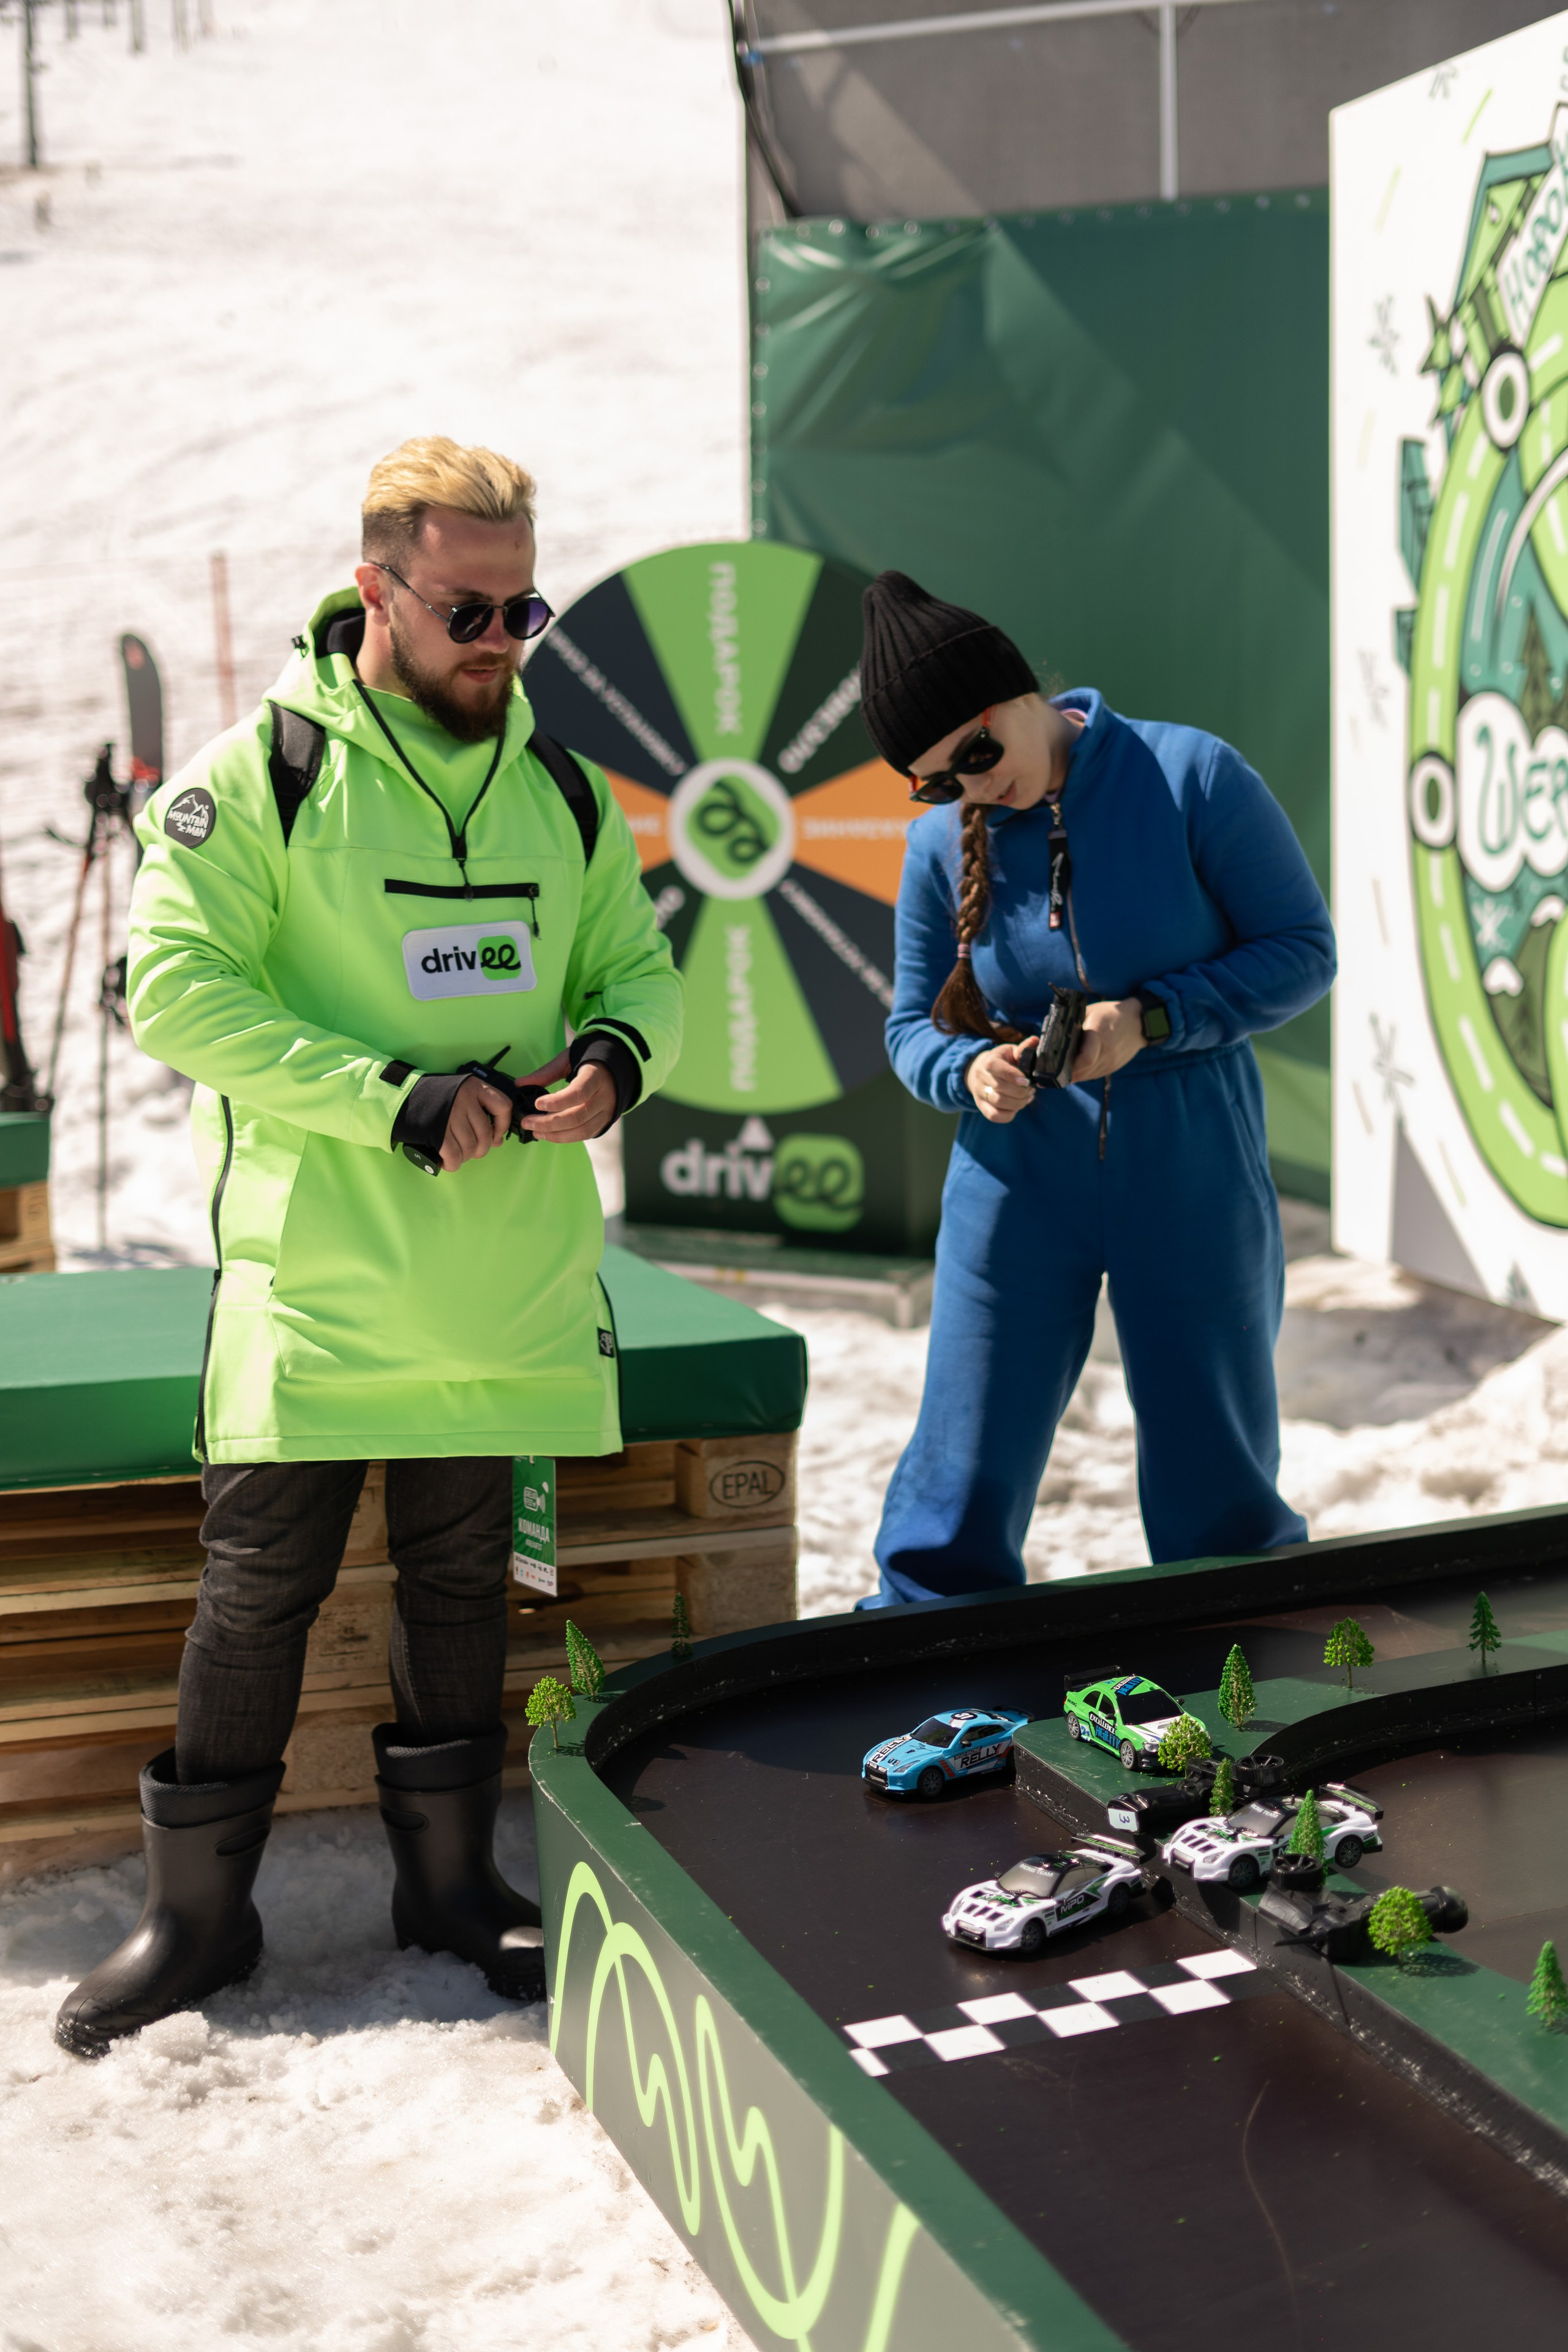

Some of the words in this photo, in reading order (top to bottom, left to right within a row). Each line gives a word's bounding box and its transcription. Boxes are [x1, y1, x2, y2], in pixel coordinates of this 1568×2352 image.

[709, 562, 742, 736] ПОДАРОК
[167, 809, 209, 829] MOUNTAIN
[185, 824, 207, 839] MAN
[421, 944, 522, 974] drivee
[660, 1138, 864, 1212] drivee
[722, 1471, 774, 1499] EPAL
[518, 1517, 550, 1544] КОМАНДА
[1090, 1713, 1116, 1735] EXCELLENCE
[960, 1743, 1000, 1768] RELLY
[1263, 1809, 1279, 1819] TEAM
[1085, 1838, 1137, 1855] SUPERIOR
[1019, 1863, 1036, 1874] RACING
[1036, 1869, 1054, 1878] TEAM
[1060, 1894, 1085, 1914] MPO
